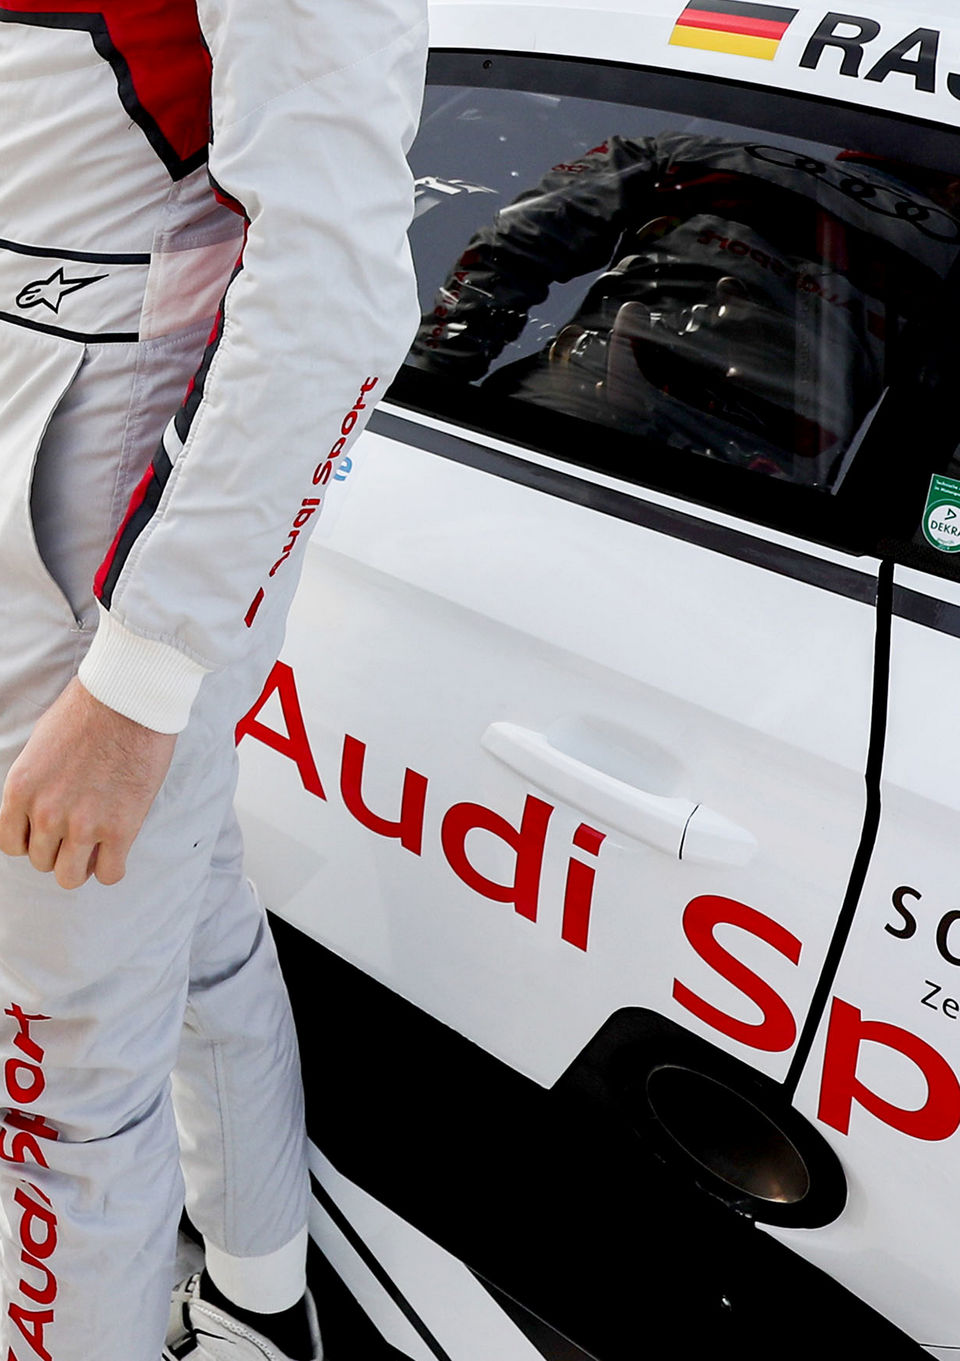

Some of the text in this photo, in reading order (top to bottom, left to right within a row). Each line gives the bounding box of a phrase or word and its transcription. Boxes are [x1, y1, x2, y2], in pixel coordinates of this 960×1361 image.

[312, 376, 379, 486] Sport
[234, 660, 960, 1143] Audi Sp
[920, 979, 960, 1020] Ze
